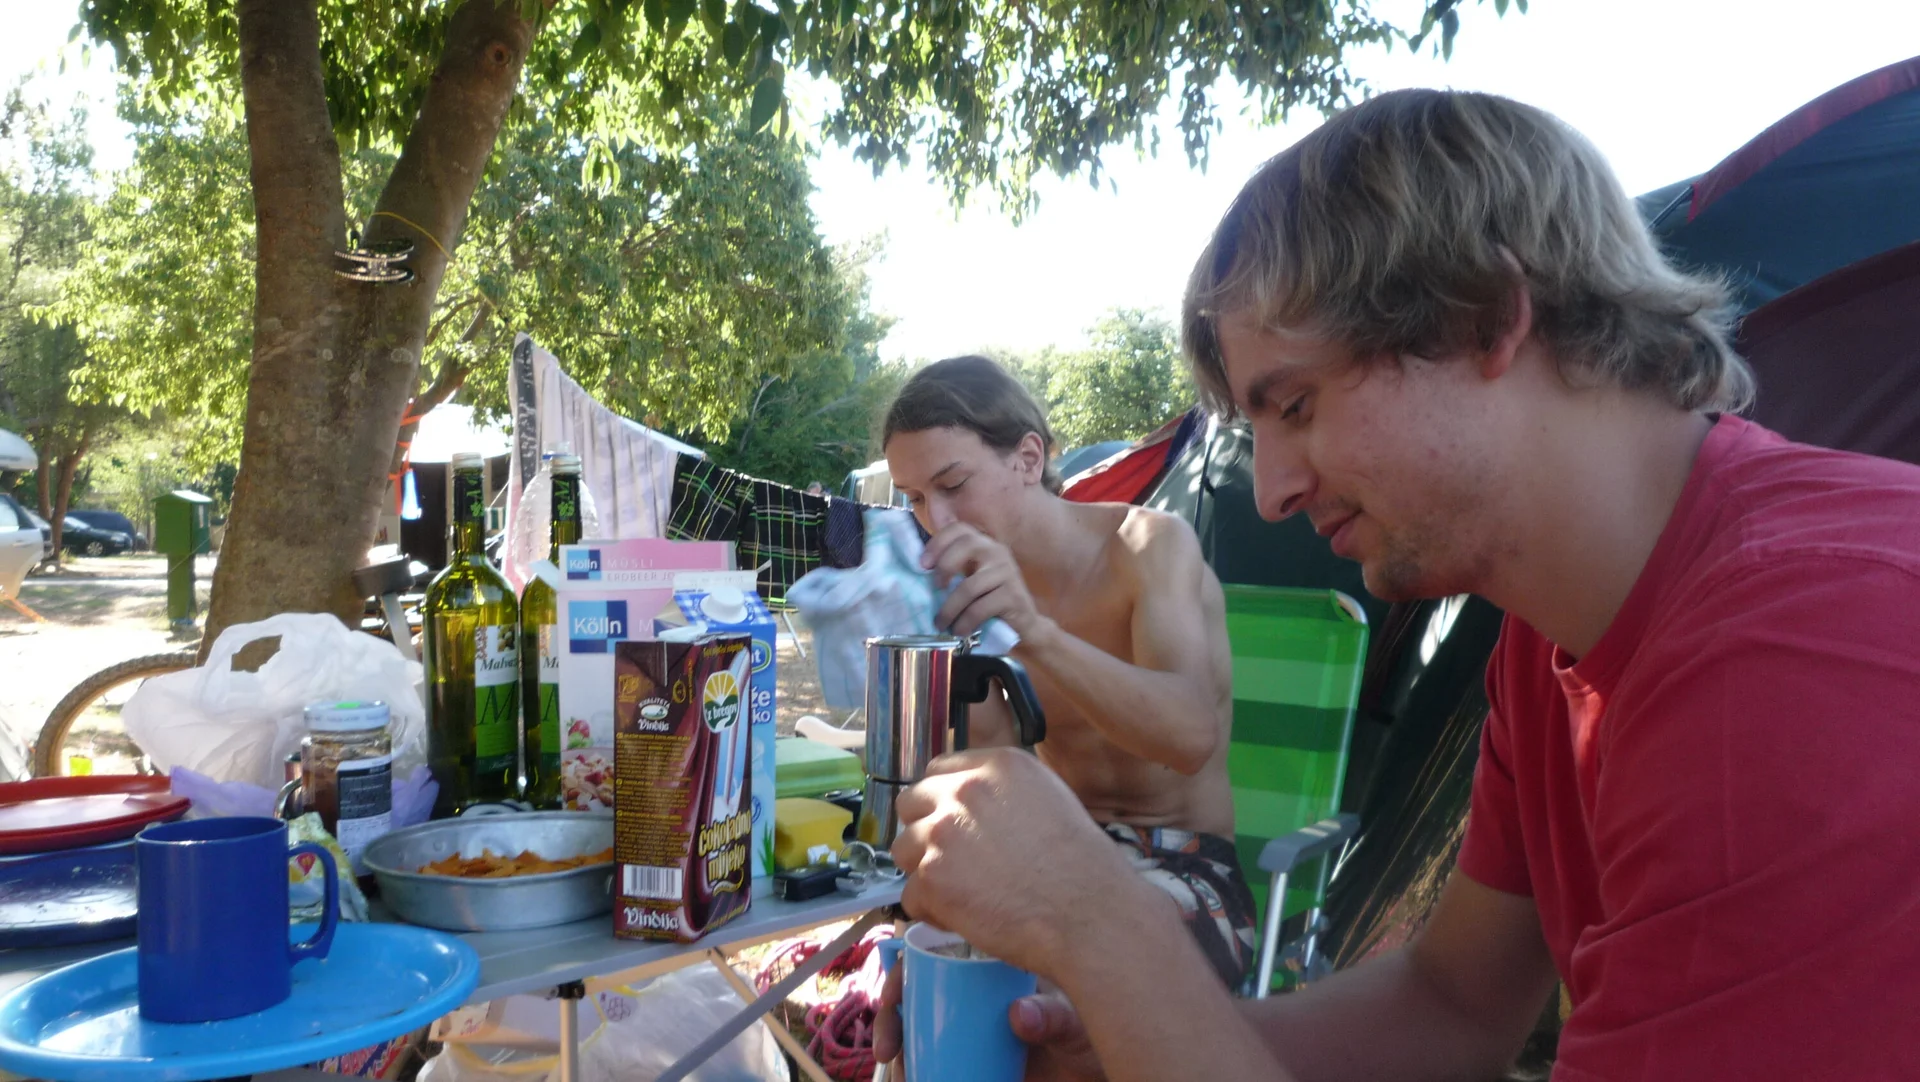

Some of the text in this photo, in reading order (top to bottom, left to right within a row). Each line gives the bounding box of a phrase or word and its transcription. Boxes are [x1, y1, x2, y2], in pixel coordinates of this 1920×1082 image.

[569, 557, 598, 570] Kölln
[607, 572, 657, 582] ERDBEER
[574, 617, 622, 635] Kölln
[638, 696, 671, 709] KVALITETA
[637, 717, 670, 732] Vindija
[698, 808, 751, 857] Čokoladno
[708, 844, 746, 882] mlijeko
[623, 906, 680, 931] Vindija
